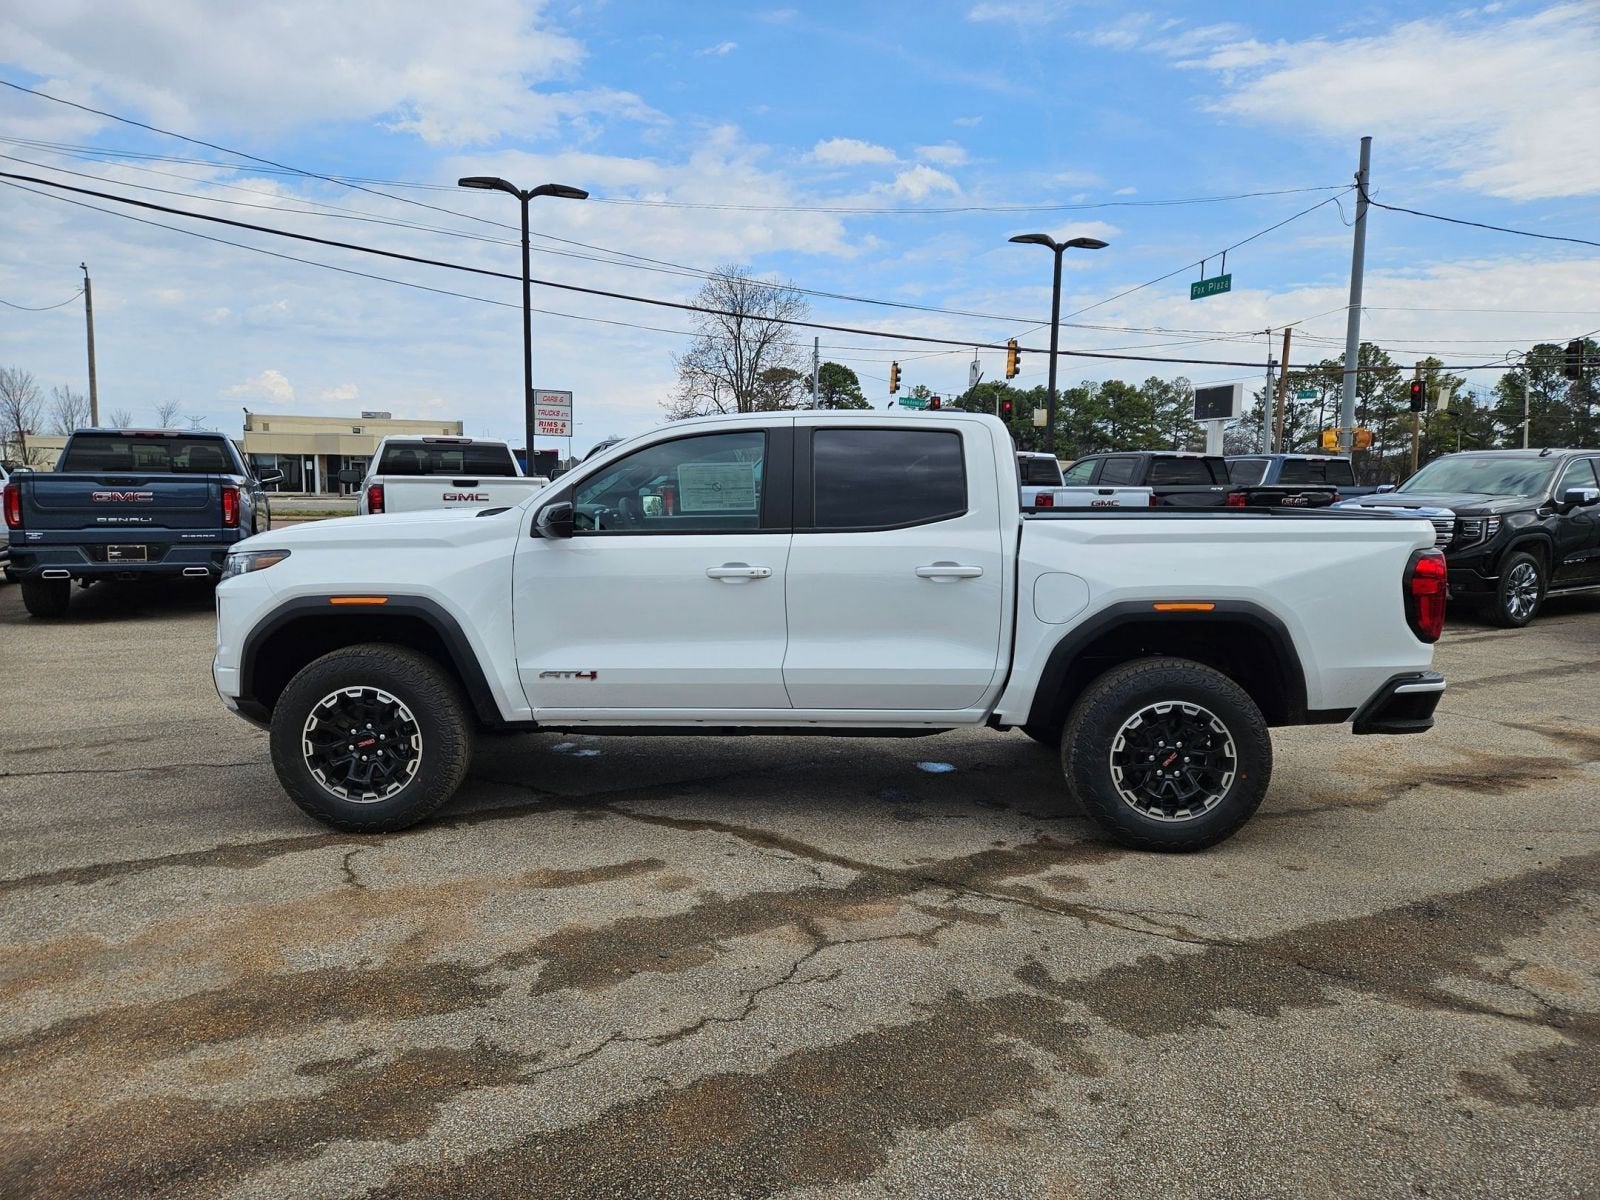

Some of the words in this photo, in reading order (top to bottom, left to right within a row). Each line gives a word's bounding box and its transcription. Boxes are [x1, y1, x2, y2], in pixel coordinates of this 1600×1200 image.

[1193, 287, 1206, 295] Fox
[1208, 280, 1229, 291] Plaza
[537, 409, 560, 417] TRUCKS
[538, 420, 558, 428] RIMS
[92, 491, 153, 502] GMC
[442, 493, 490, 502] GMC
[539, 670, 597, 680] AT4
[1162, 752, 1178, 767] GMC
